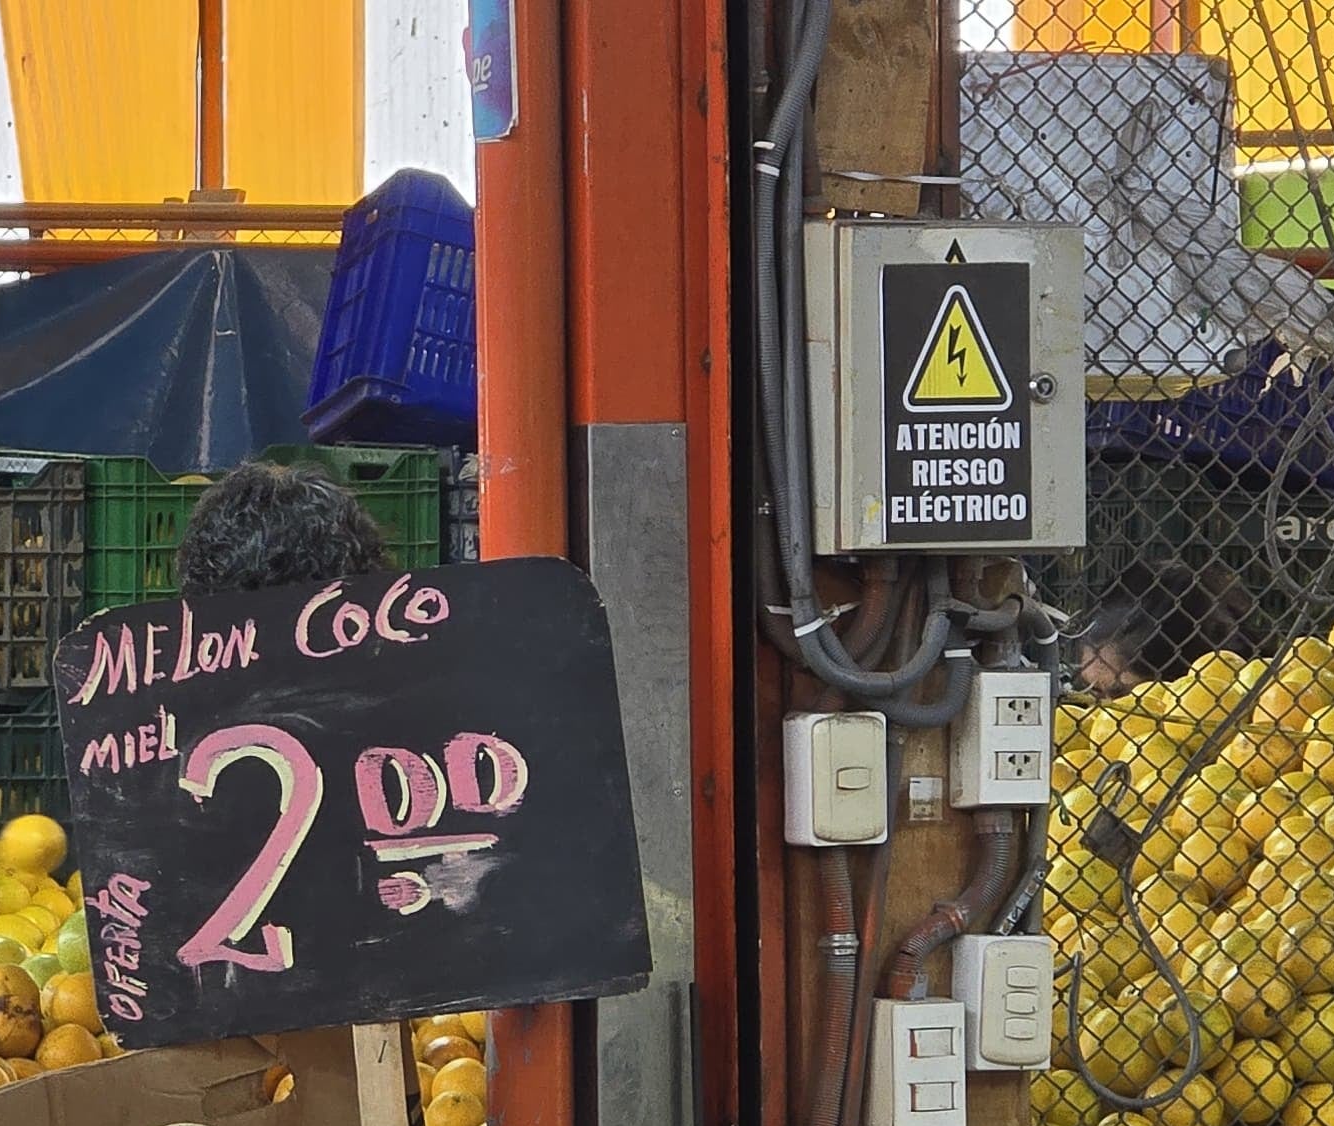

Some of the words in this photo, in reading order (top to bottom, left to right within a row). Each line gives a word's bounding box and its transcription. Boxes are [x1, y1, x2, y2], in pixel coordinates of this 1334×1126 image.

[896, 416, 1021, 451] ATENCIÓN
[912, 458, 1005, 487] RIESGO
[891, 491, 1028, 524] ELÉCTRICO
[79, 704, 179, 774] MIEL
[177, 723, 324, 972] 2
[355, 731, 529, 834] 00
